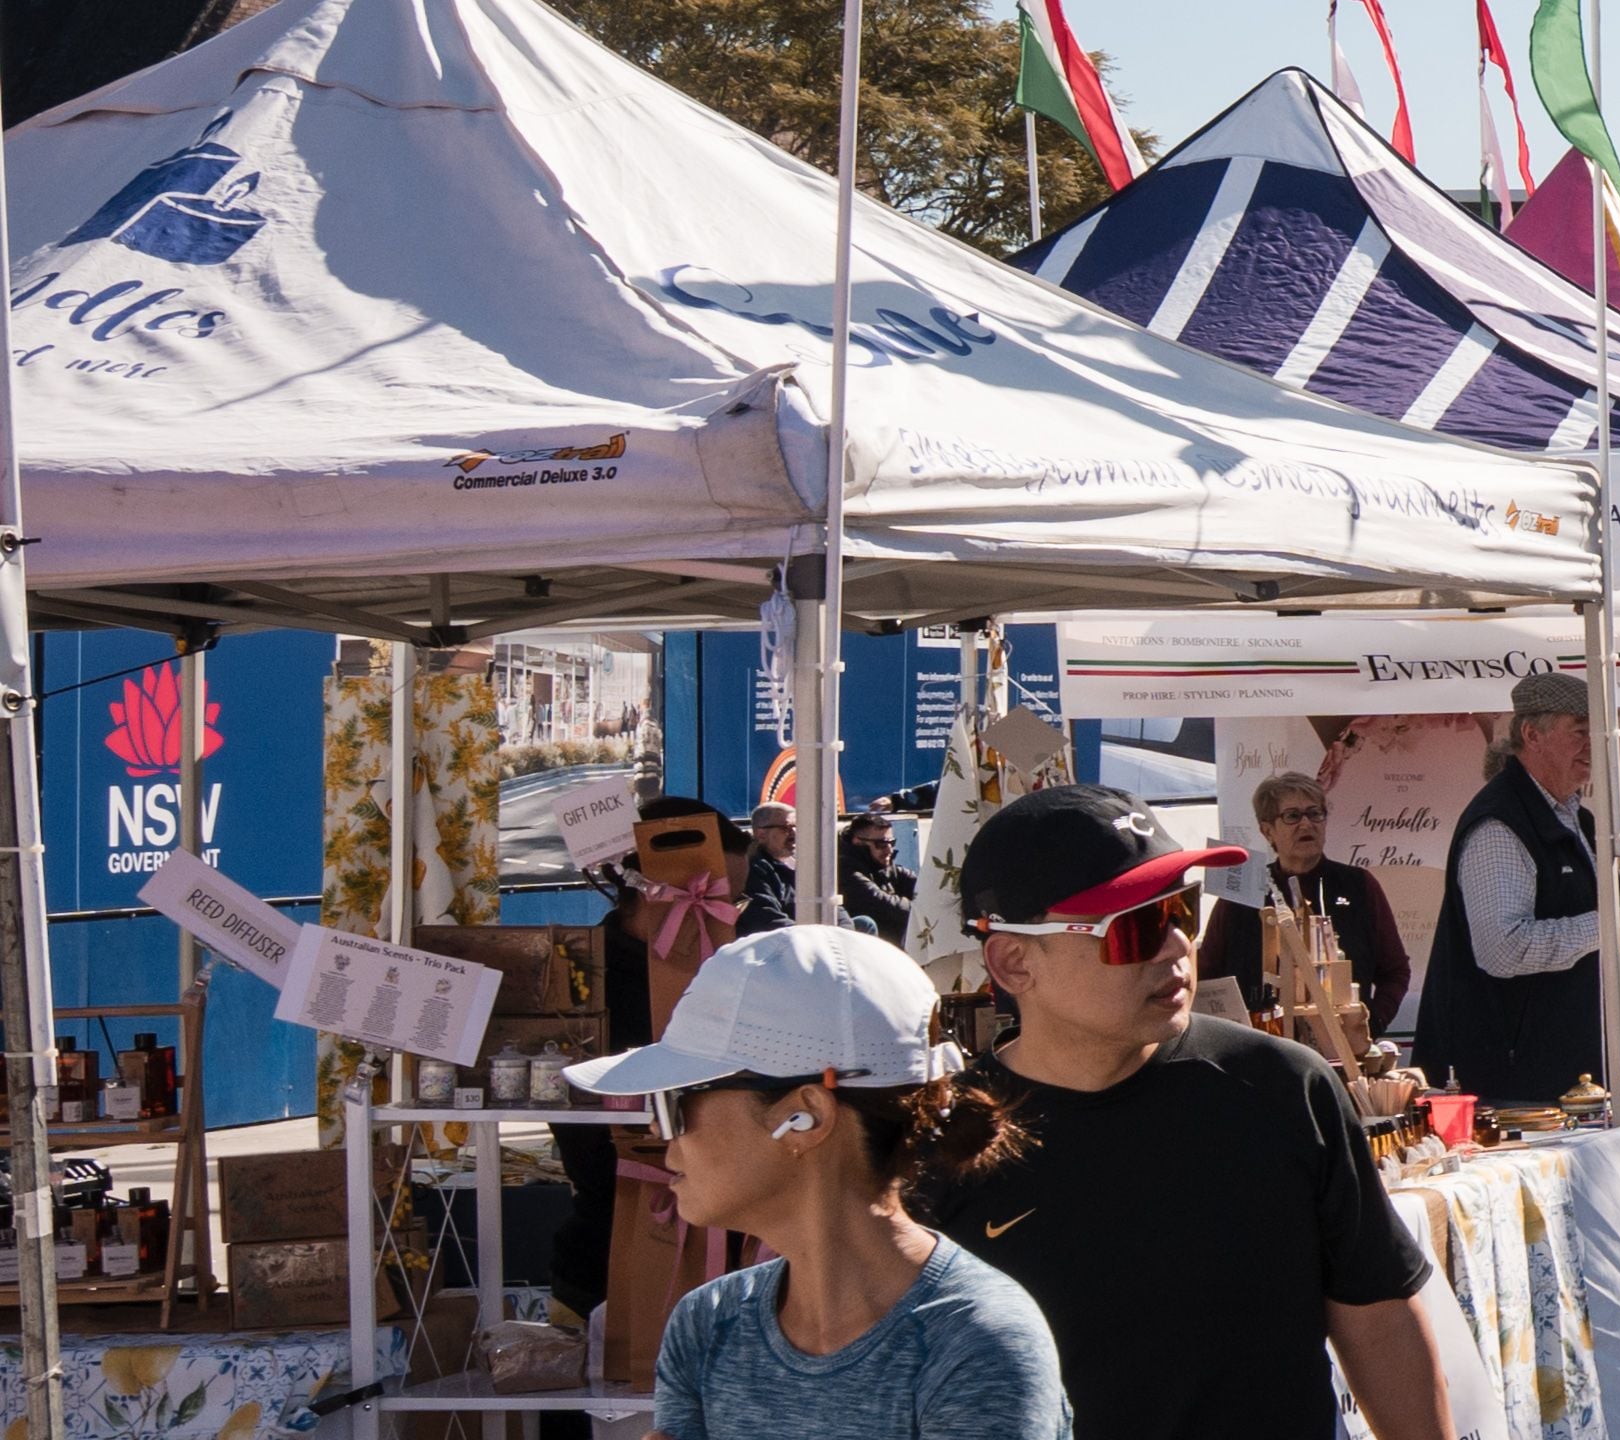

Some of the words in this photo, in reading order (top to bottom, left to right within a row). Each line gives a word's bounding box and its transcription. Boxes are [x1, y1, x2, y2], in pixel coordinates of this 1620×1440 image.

[453, 471, 536, 491] Commercial
[539, 468, 588, 485] Deluxe
[592, 466, 617, 481] 3.0
[1102, 635, 1165, 647] INVITATIONS
[1171, 637, 1240, 648] BOMBONIERE
[1122, 691, 1149, 701] PROP
[1150, 690, 1176, 701] HIRE
[1183, 690, 1231, 700] STYLING
[1238, 688, 1294, 699] PLANNING
[563, 806, 588, 827] GIFT
[590, 794, 625, 817] PACK
[186, 888, 226, 920] REED
[222, 912, 287, 965] DIFFUSER
[330, 934, 381, 955] Australian
[382, 944, 415, 963] Scents
[424, 957, 442, 970] Trio
[444, 961, 467, 976] Pack
